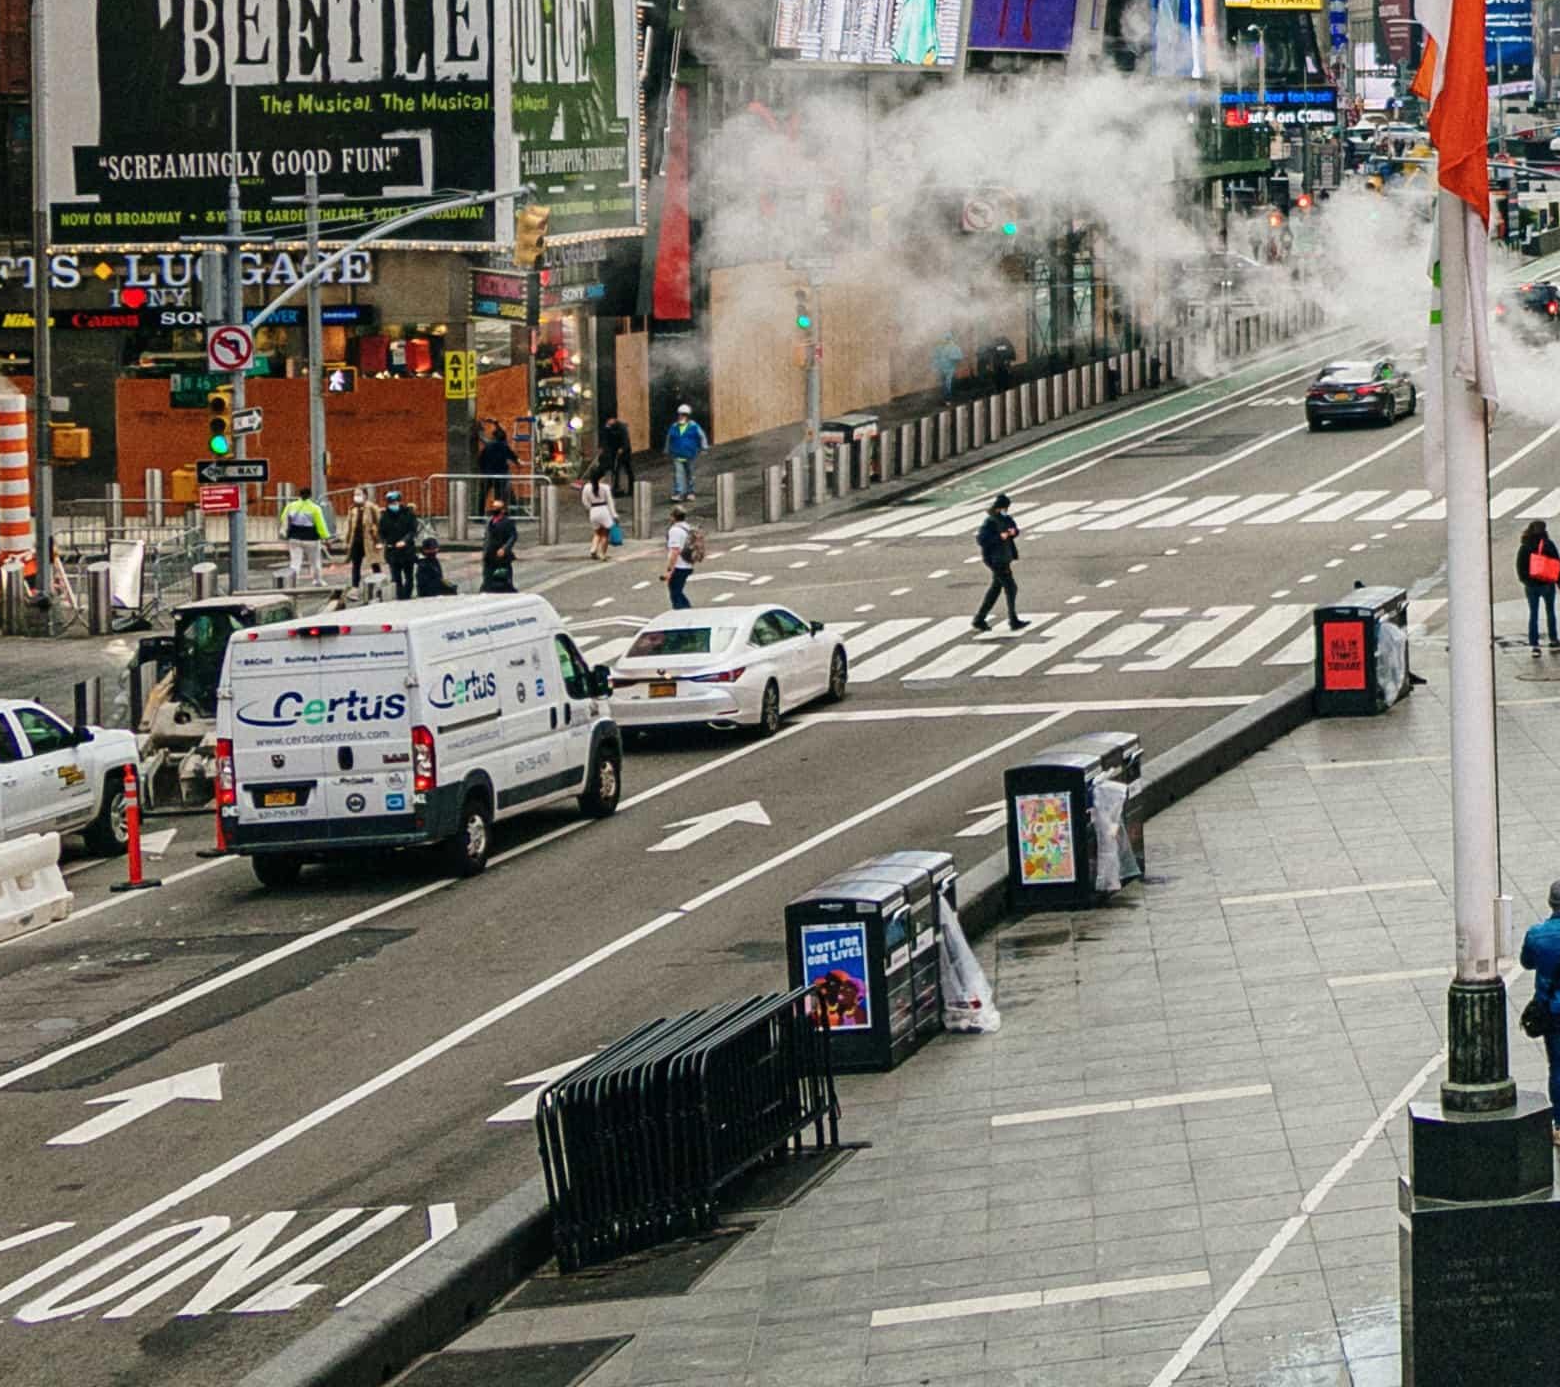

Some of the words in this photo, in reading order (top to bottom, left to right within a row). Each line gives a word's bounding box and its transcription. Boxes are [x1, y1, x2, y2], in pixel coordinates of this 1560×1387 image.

[260, 93, 290, 116] The
[382, 91, 416, 115] The
[271, 149, 333, 175] GOOD
[60, 210, 92, 226] NOW
[95, 210, 113, 225] ON
[115, 209, 182, 225] BROADWAY
[72, 313, 140, 328] Canon
[449, 354, 463, 392] ATM
[441, 668, 497, 707] Certus
[273, 688, 408, 727] Certus
[808, 941, 836, 956] VOTE
[838, 937, 860, 951] FOR
[831, 946, 863, 963] LIVES
